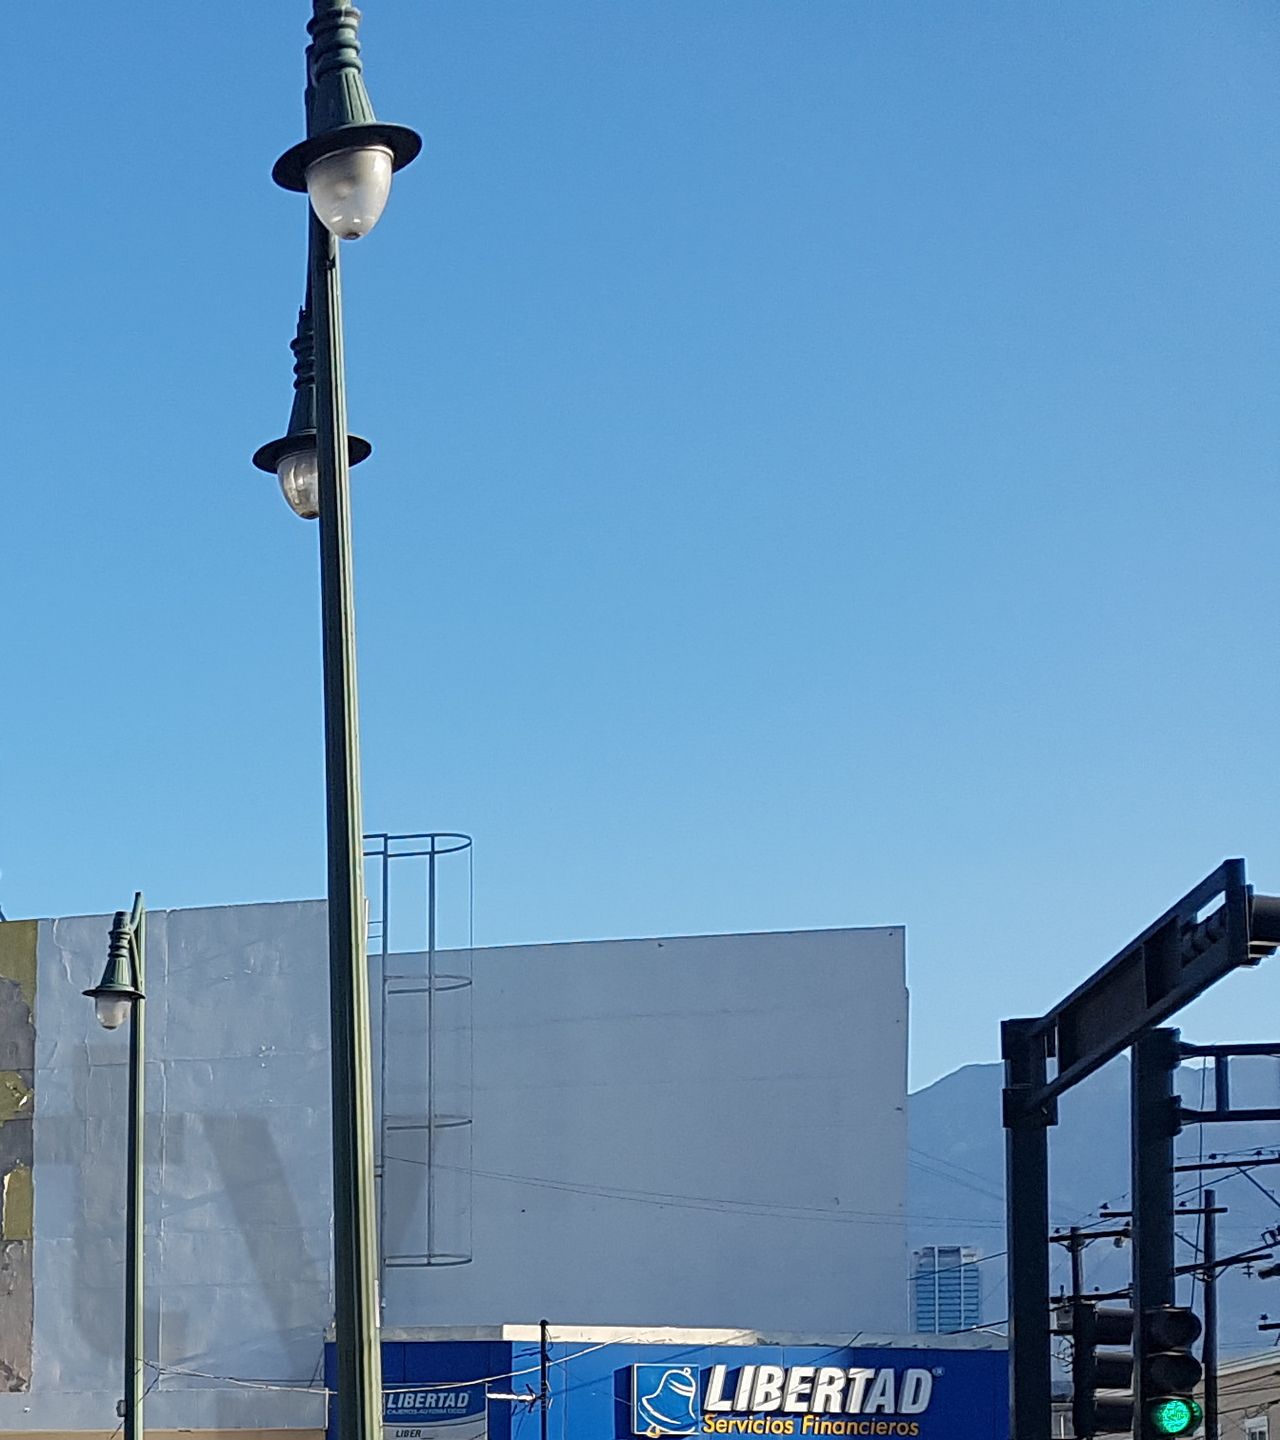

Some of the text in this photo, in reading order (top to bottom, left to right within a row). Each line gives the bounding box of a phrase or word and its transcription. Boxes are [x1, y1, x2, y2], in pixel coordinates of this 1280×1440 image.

[386, 1392, 470, 1408] LIBERTAD
[703, 1363, 933, 1414] LIBERTAD
[703, 1412, 919, 1436] Servicios Financieros
